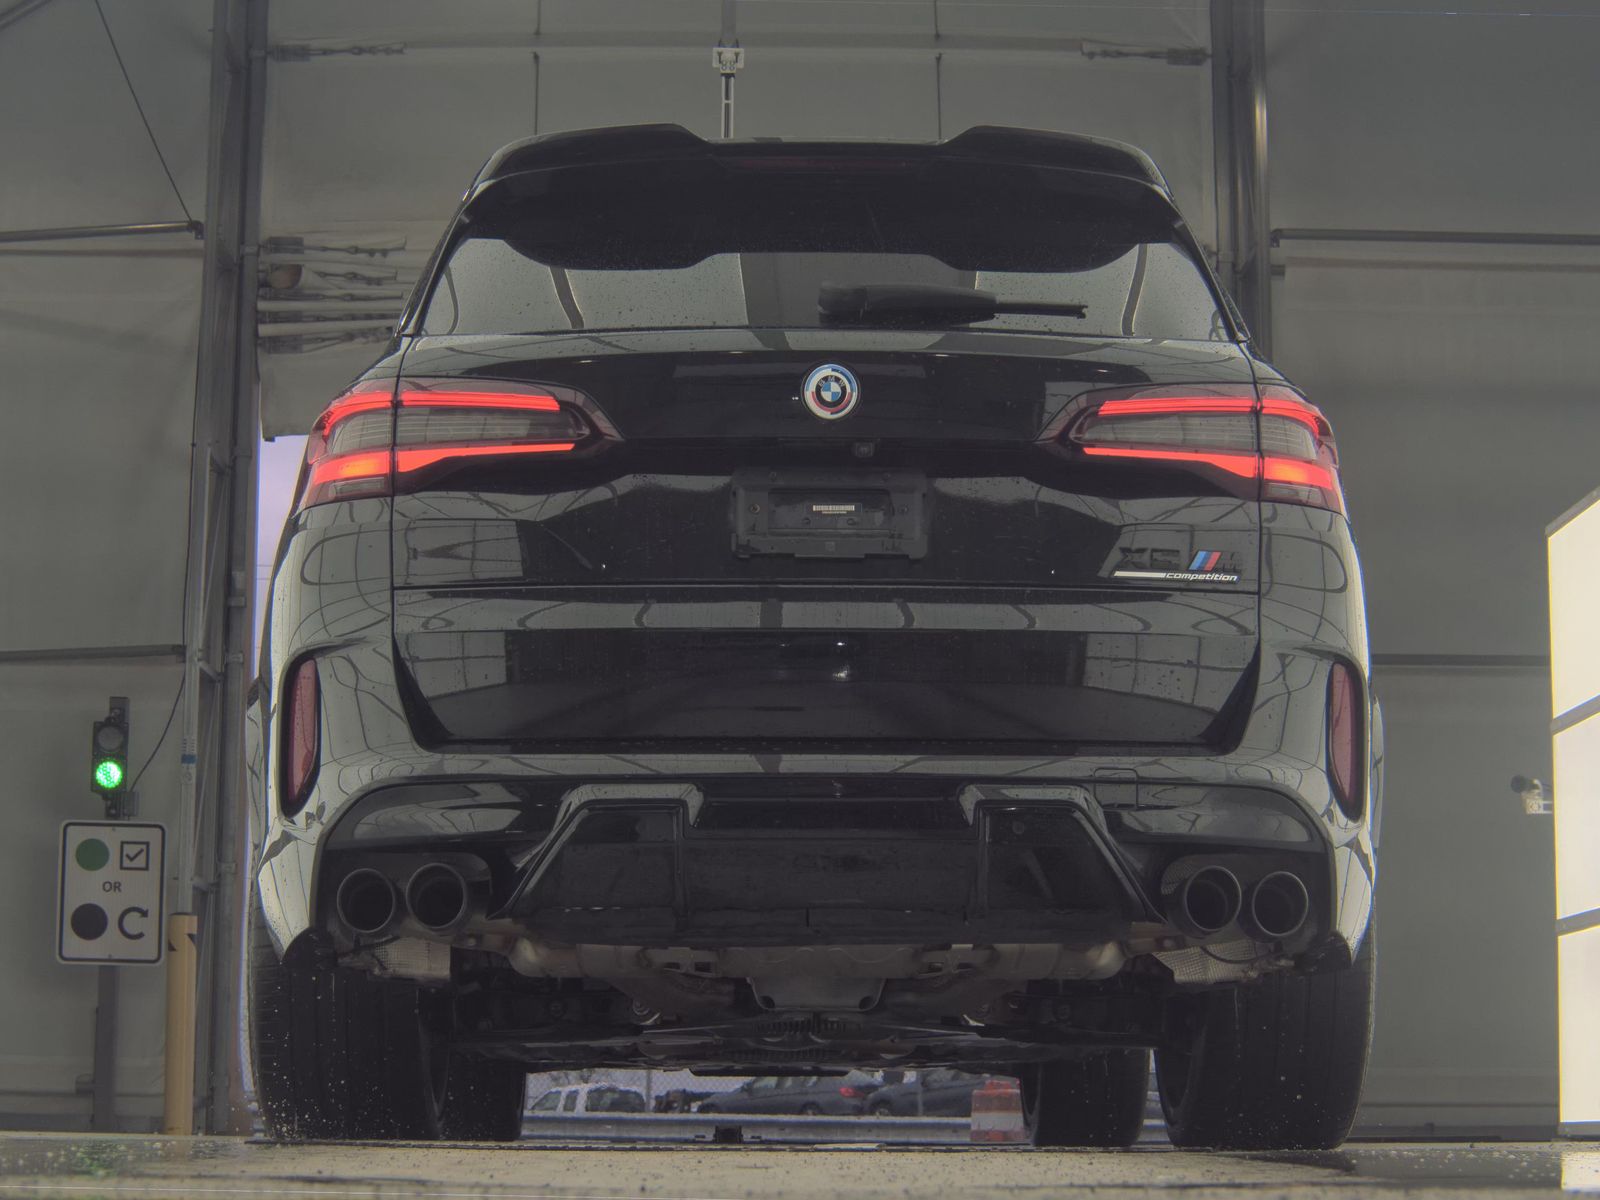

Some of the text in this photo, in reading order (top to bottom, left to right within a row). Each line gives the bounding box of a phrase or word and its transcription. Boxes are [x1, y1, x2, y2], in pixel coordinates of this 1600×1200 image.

[817, 375, 847, 387] BMW
[1165, 572, 1238, 582] competition
[102, 881, 122, 893] OR
